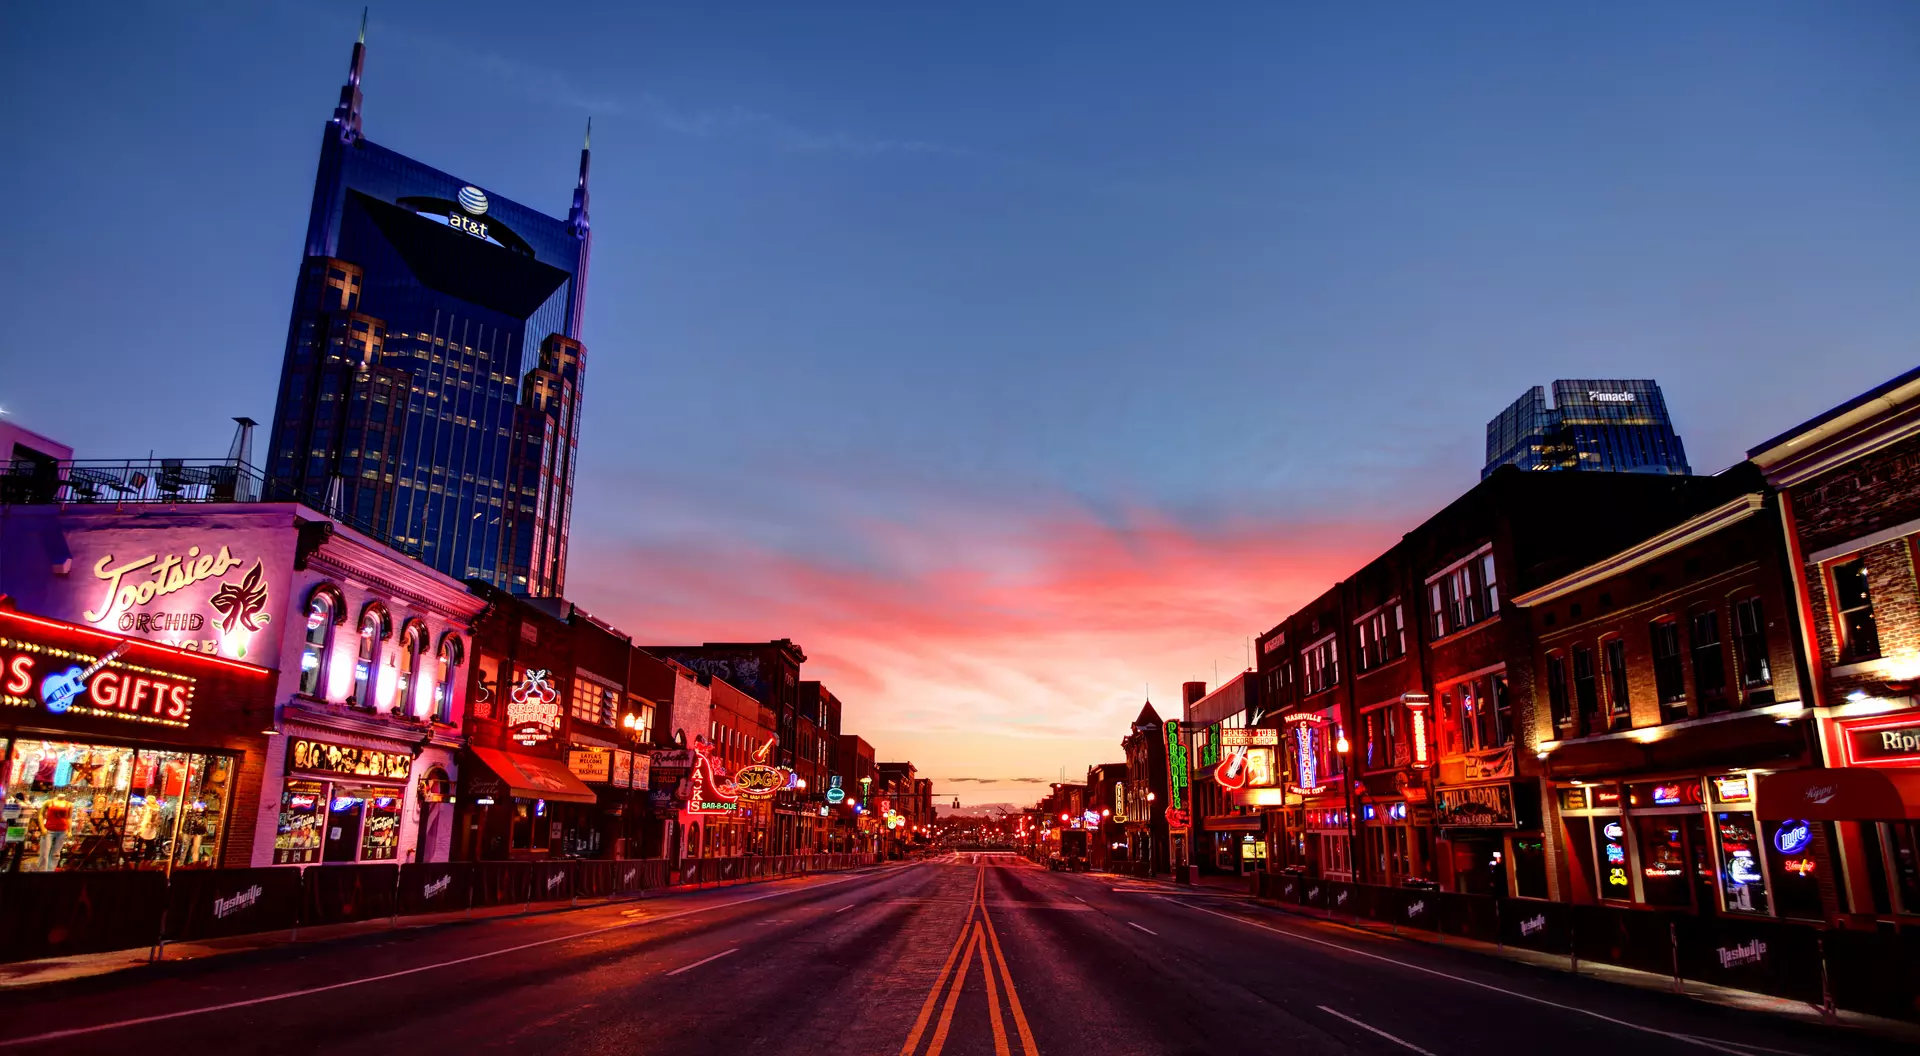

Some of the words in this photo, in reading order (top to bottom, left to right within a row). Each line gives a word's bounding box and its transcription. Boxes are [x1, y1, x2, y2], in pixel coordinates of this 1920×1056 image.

[450, 214, 488, 238] at&t
[1589, 391, 1635, 402] Pinnacle
[84, 545, 243, 623] Tootsies
[118, 612, 204, 632] ORCHID
[91, 671, 187, 718] GIFTS
[507, 703, 558, 717] SECOND
[508, 713, 555, 727] FIDDLE
[1284, 713, 1321, 722] NASHVILLE
[1222, 729, 1252, 737] ERNEST
[1256, 729, 1277, 737] TUBB
[1300, 721, 1312, 787] CROSSROADS
[1168, 722, 1181, 809] PARADISE
[1179, 746, 1188, 787] PARK
[738, 770, 780, 788] STAGE
[1443, 789, 1467, 814] FULL
[1468, 787, 1501, 814] MOON
[1455, 813, 1492, 825] SALOON
[1716, 939, 1766, 968] Nashville
